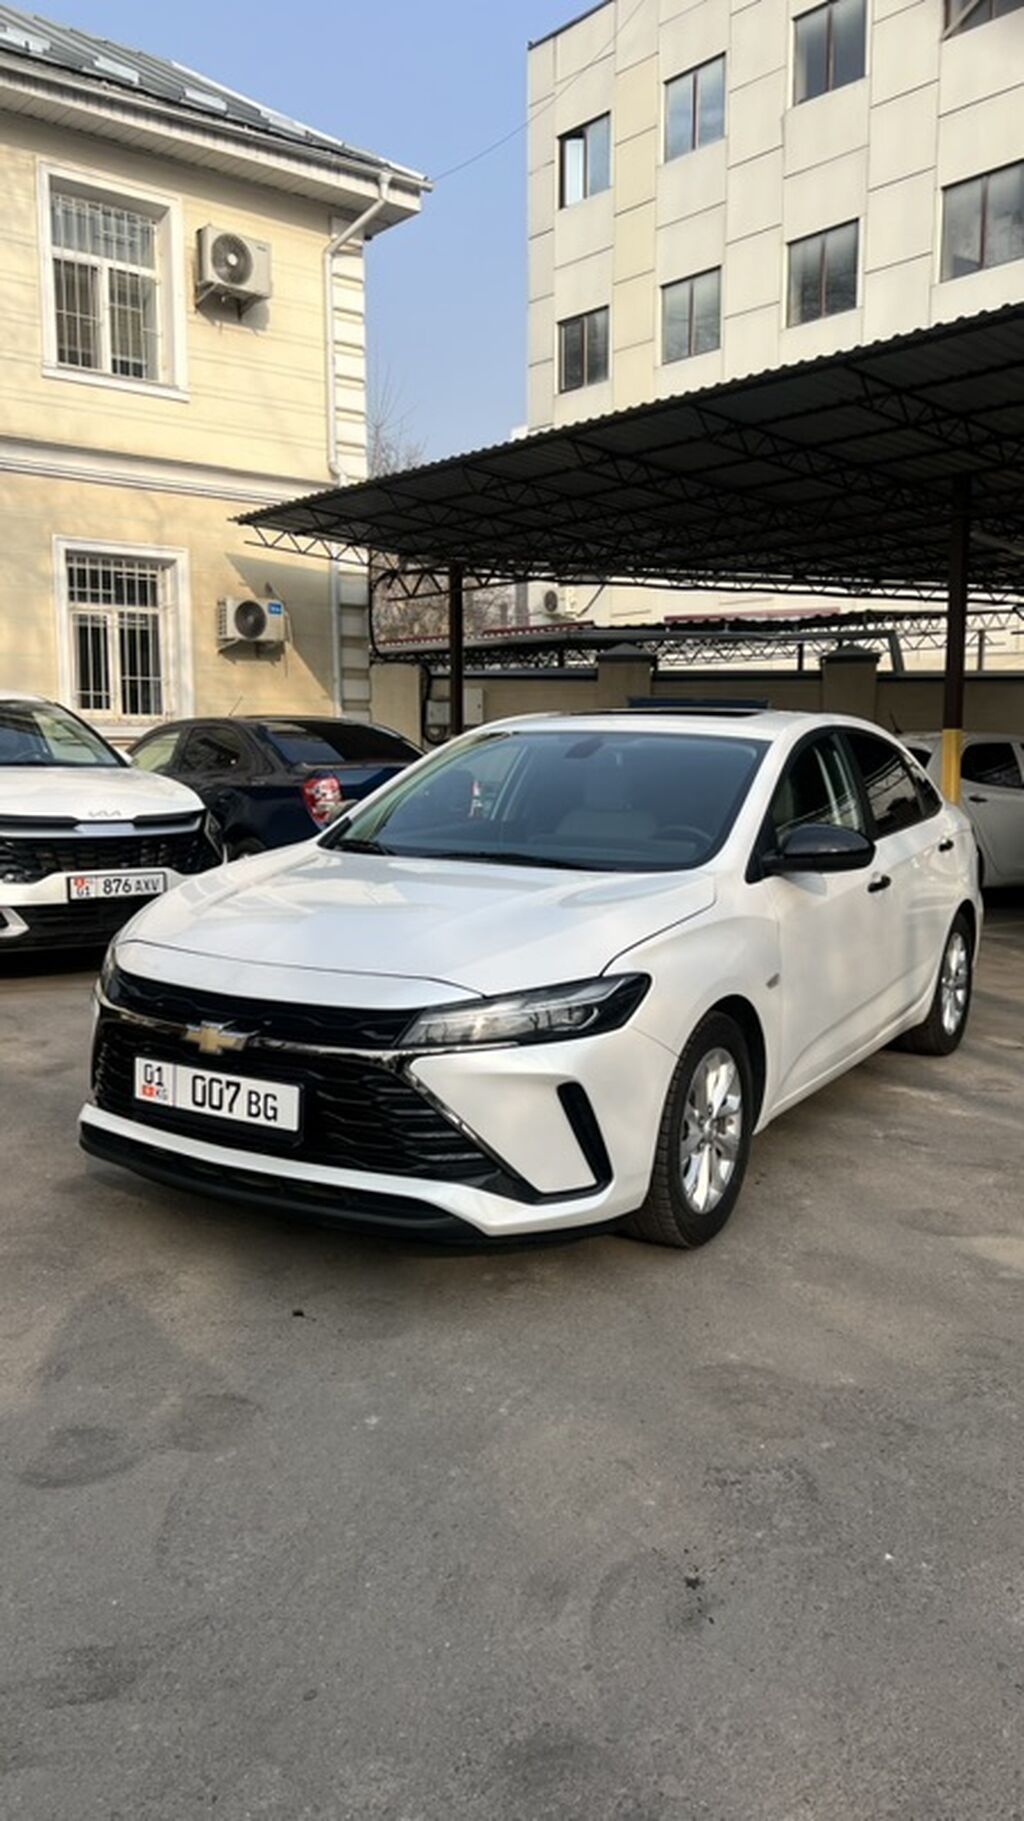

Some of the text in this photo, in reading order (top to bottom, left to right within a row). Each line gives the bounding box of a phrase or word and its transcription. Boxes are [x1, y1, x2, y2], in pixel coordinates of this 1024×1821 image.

[103, 878, 160, 895] 876 AXV
[144, 1064, 163, 1087] 01
[191, 1074, 278, 1122] 007 BG
